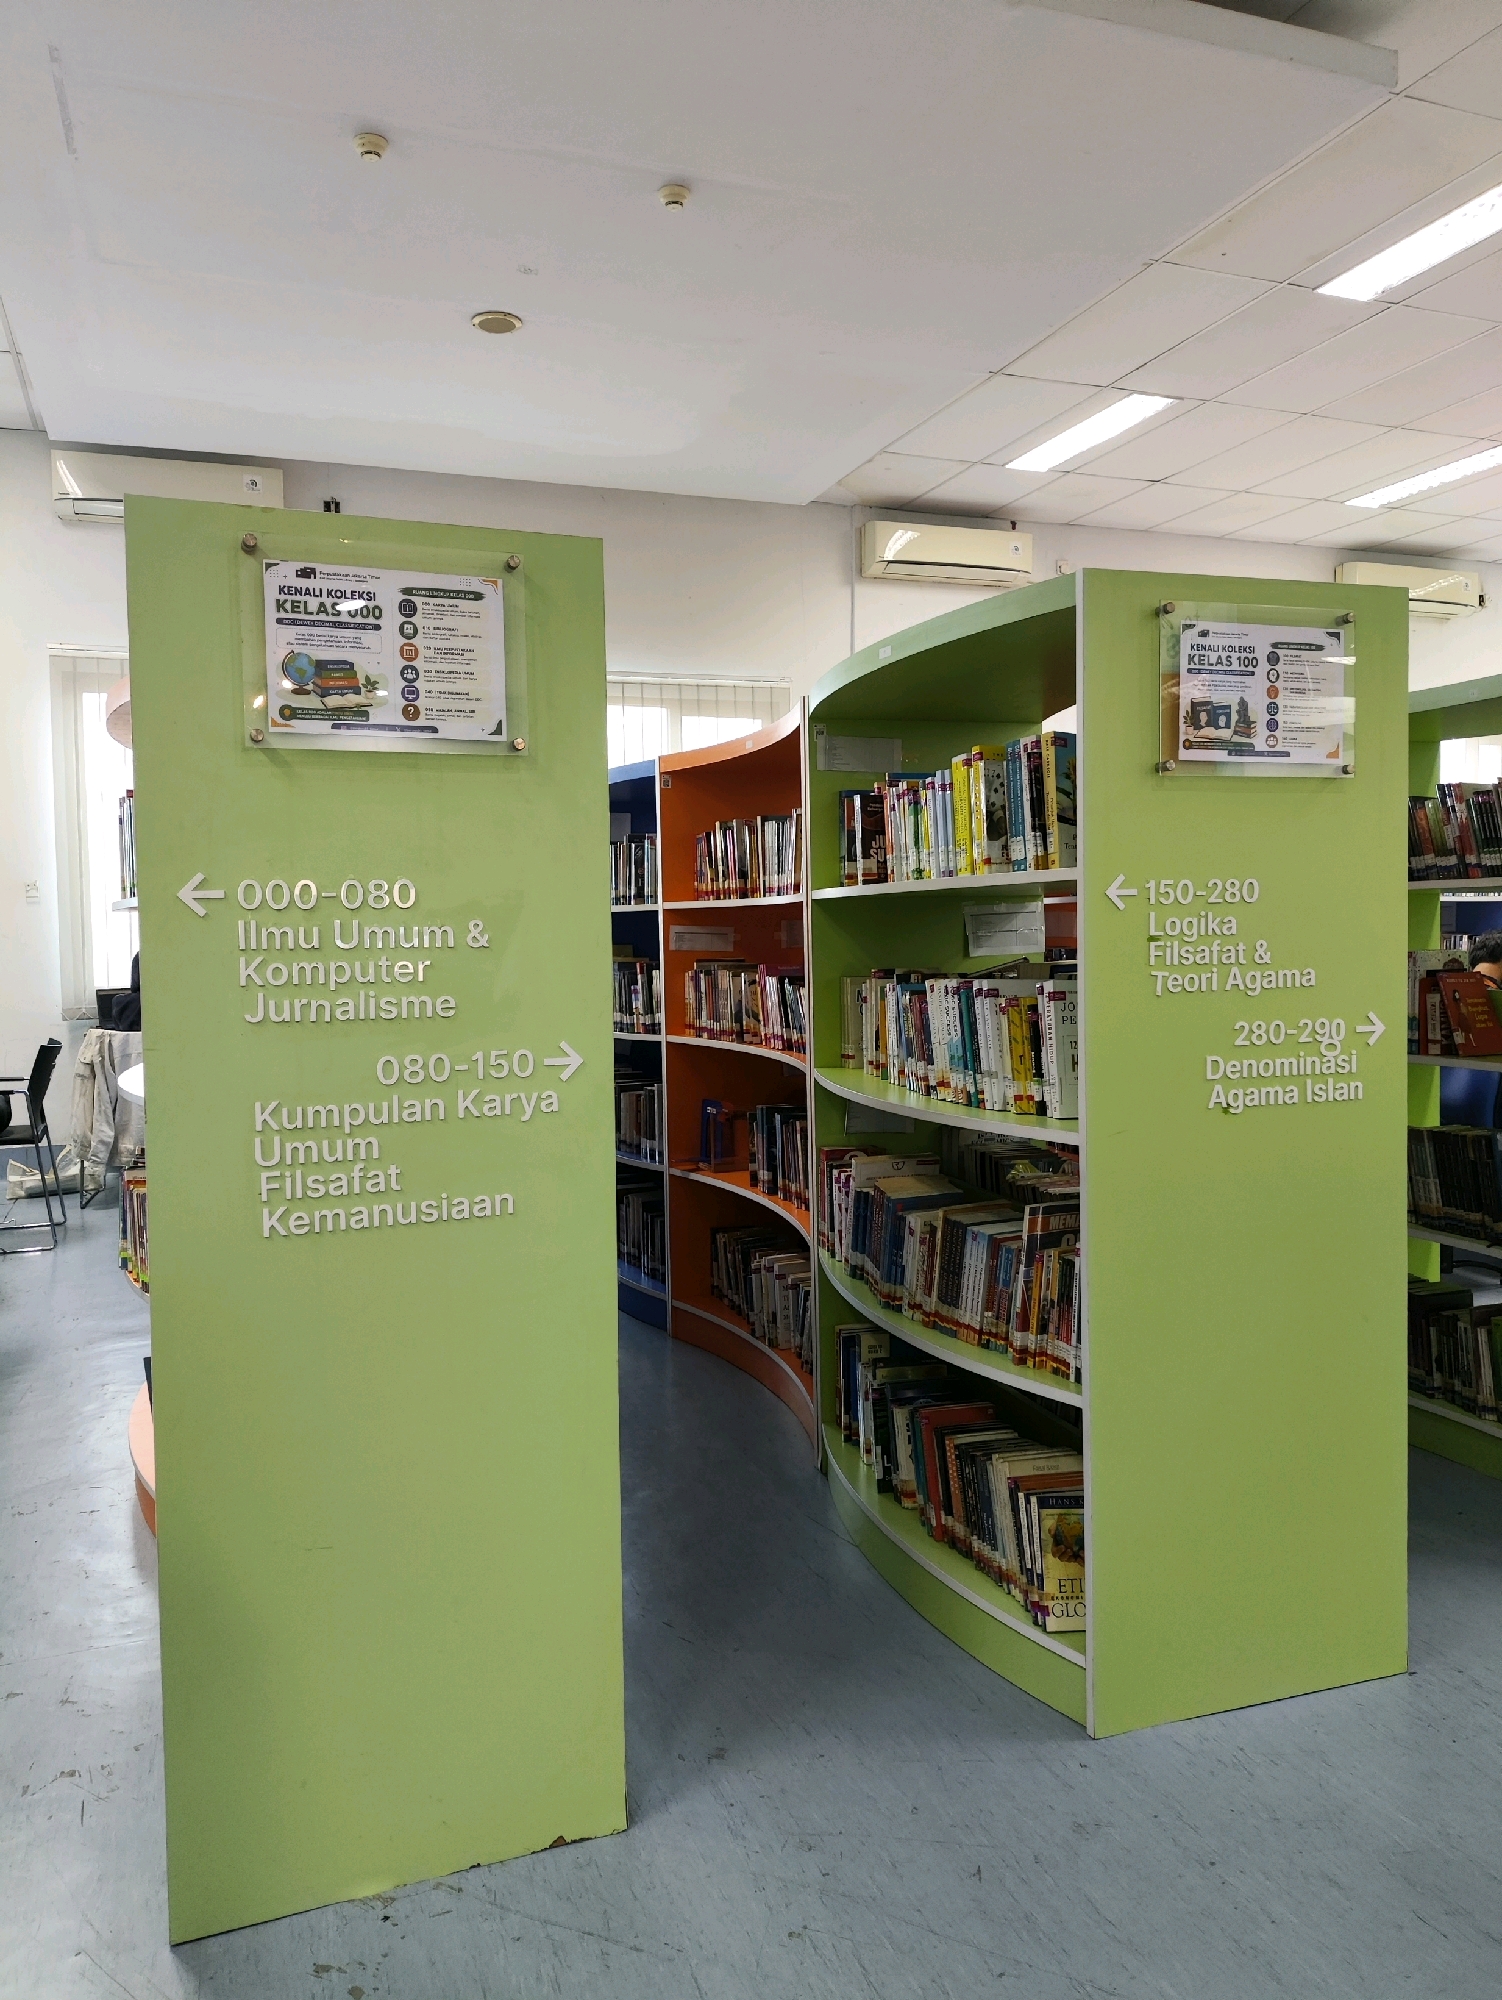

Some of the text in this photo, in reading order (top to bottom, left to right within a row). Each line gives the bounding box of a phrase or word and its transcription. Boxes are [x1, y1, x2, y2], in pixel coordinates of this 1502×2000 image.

[276, 599, 341, 617] KELAS
[278, 585, 376, 601] KENALI KOLEKSI
[1187, 654, 1259, 669] KELAS 100
[1190, 643, 1255, 654] KENALI KOLEKSI
[237, 878, 416, 910] 000-080
[1145, 878, 1259, 905] 150-280
[237, 919, 490, 951] Ilmu Umum &
[1149, 911, 1237, 942] Logika
[1149, 939, 1271, 966] Filsafat &
[239, 956, 431, 990] Komputer
[1151, 967, 1316, 996] Teori Agama
[244, 990, 456, 1023] Jurnalisme
[1234, 1018, 1346, 1046] 280-290
[376, 1049, 534, 1085] 080-150
[1206, 1050, 1357, 1080] Denominasi
[254, 1089, 559, 1134] Kumpulan Karya
[1208, 1078, 1363, 1114] Agama Islan
[254, 1135, 379, 1167] Umum
[260, 1164, 401, 1202] Filsafat
[262, 1192, 514, 1238] Kemanusiaan
[1052, 1602, 1086, 1618] GLO
